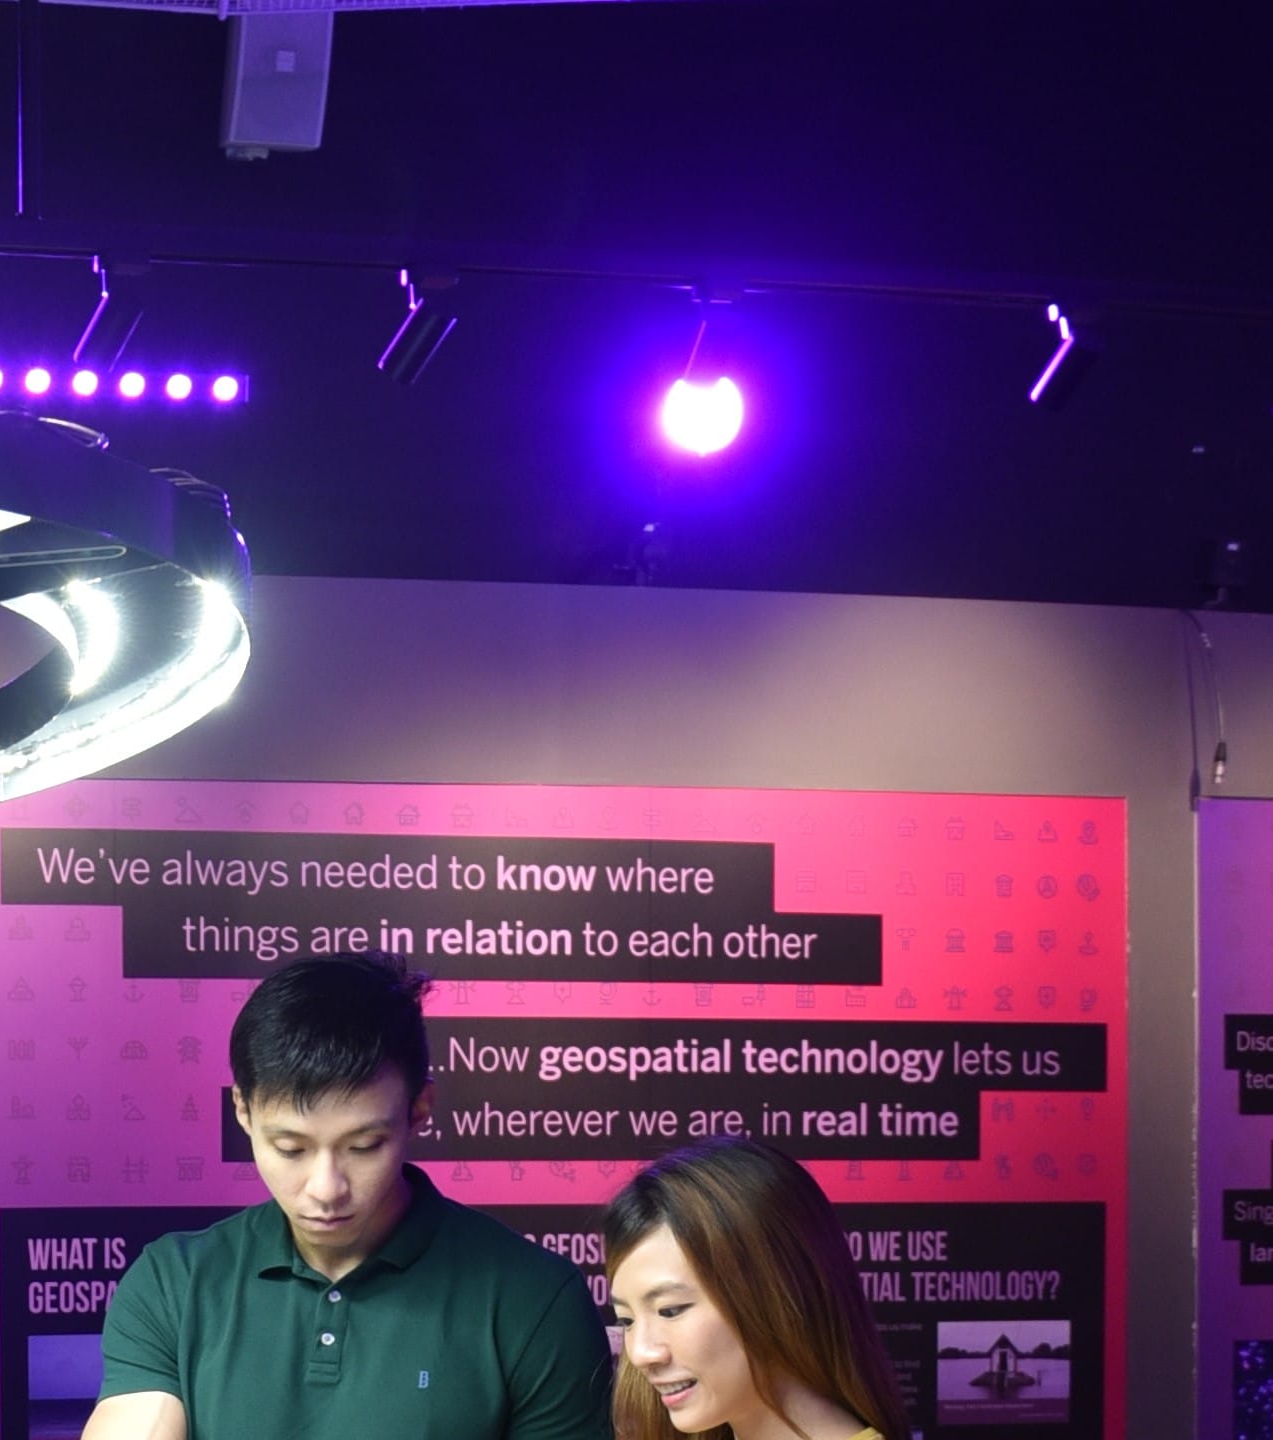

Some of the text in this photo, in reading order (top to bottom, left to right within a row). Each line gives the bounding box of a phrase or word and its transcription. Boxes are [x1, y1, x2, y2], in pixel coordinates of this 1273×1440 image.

[37, 847, 714, 895] We've always needed to know where
[182, 916, 818, 961] things are in relation to each other
[539, 1038, 731, 1080] geospatial
[742, 1041, 943, 1083] technology
[952, 1043, 1012, 1075] lets
[1020, 1052, 1061, 1075] us
[453, 1102, 618, 1137] wherever
[627, 1109, 678, 1136] we
[687, 1109, 752, 1140] are,
[762, 1103, 792, 1135] in
[802, 1101, 868, 1136] real
[878, 1102, 959, 1136] time
[27, 1237, 126, 1270] WHAT IS
[868, 1230, 902, 1262] WE
[908, 1230, 948, 1261] USE
[911, 1270, 1060, 1301] TECHNOLOGY?
